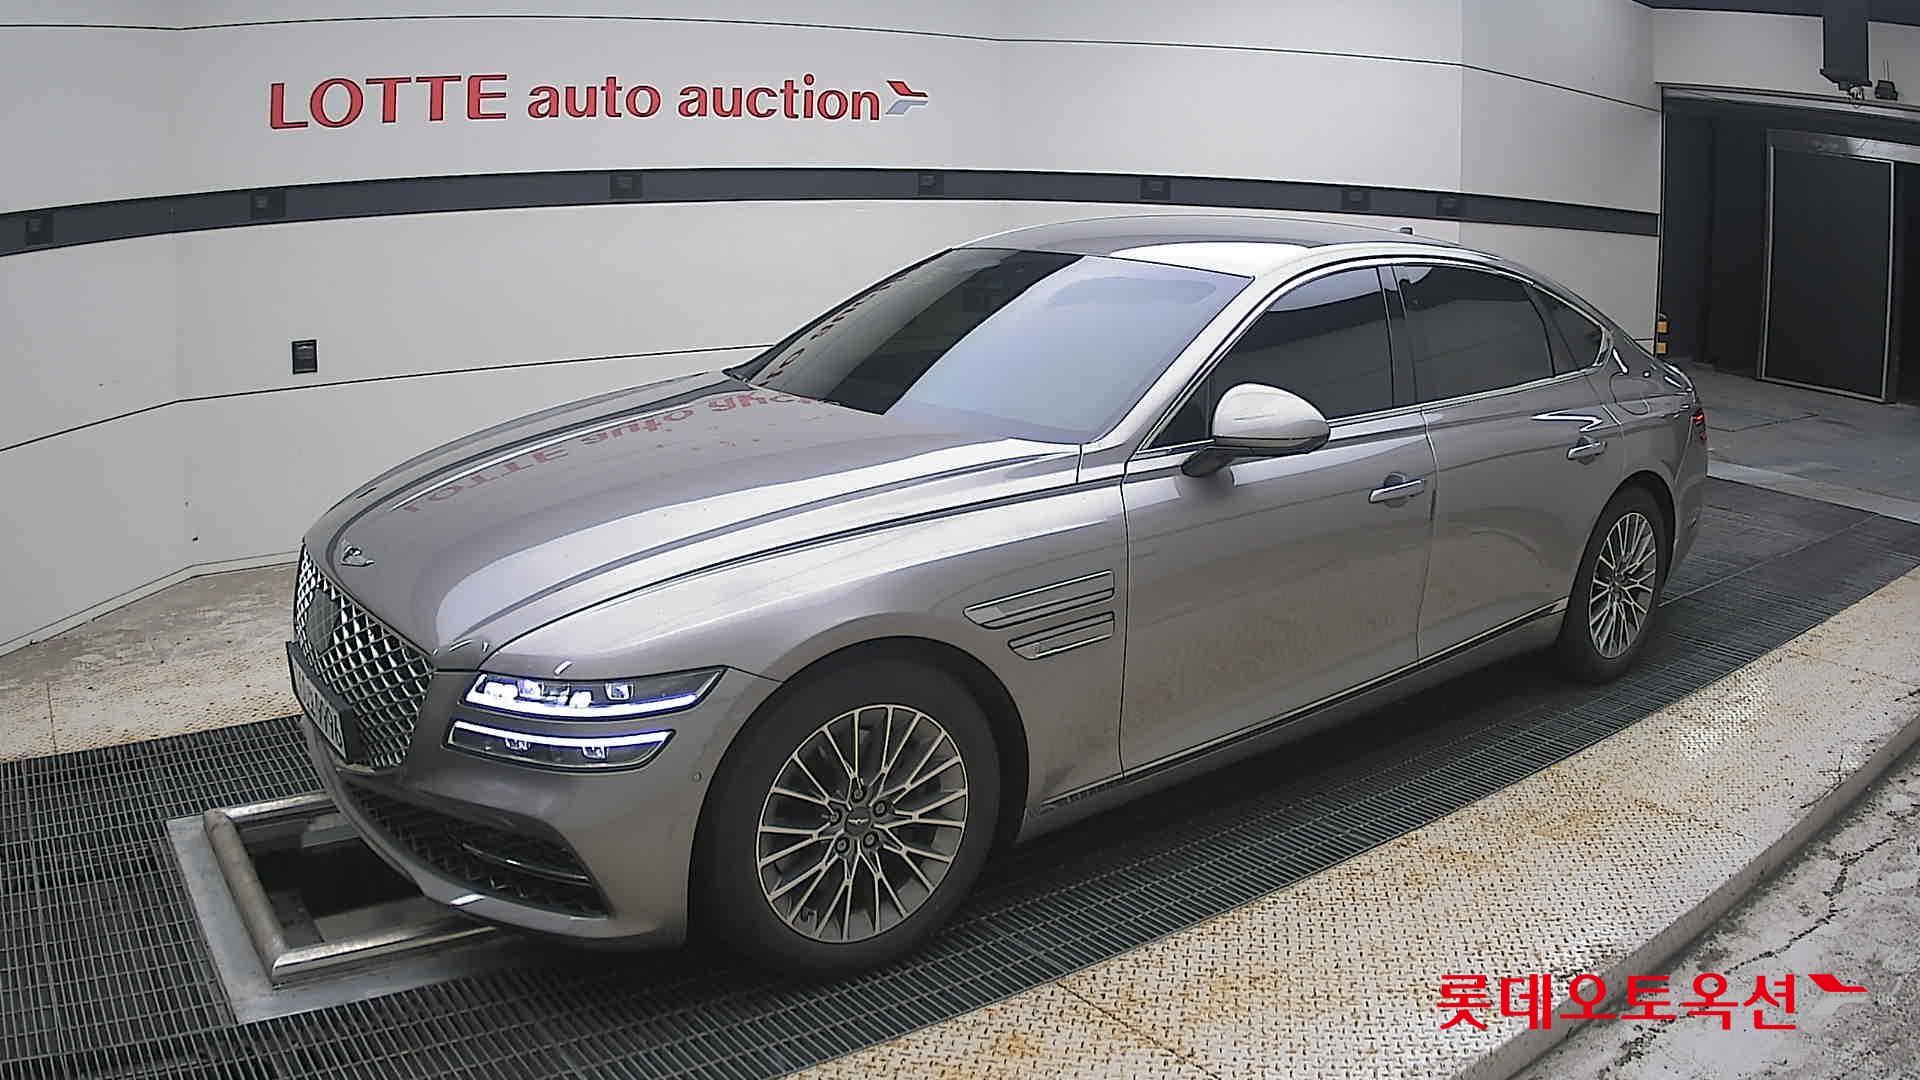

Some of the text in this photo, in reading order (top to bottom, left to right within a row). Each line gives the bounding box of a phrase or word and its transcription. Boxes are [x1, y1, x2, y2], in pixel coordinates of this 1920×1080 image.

[269, 73, 882, 130] LOTTE auto auction
